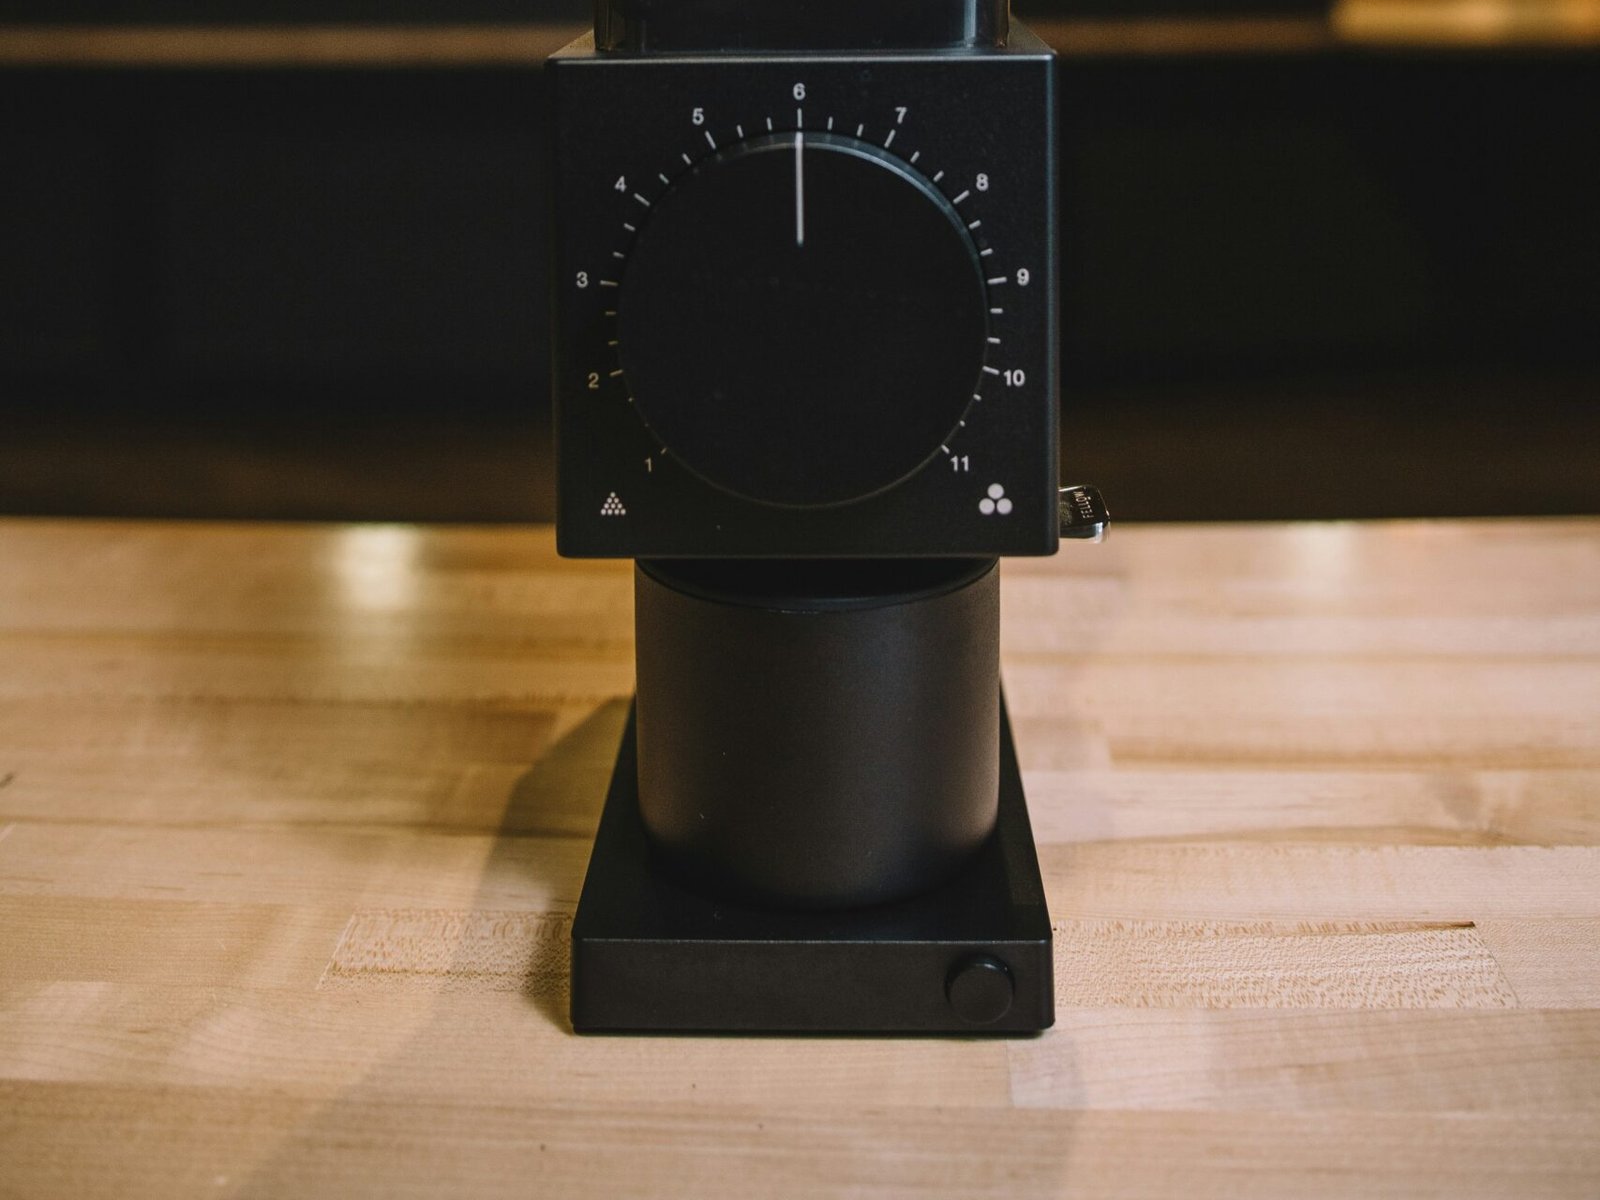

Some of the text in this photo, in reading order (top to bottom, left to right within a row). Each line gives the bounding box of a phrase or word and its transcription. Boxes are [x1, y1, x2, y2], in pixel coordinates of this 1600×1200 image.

[793, 82, 806, 100] 6
[692, 108, 705, 125] 5
[895, 107, 908, 124] 7
[614, 176, 627, 193] 4
[976, 174, 989, 191] 8
[576, 272, 589, 288] 3
[1016, 269, 1030, 286] 9
[588, 373, 599, 389] 2
[1003, 369, 1026, 387] 10
[645, 457, 653, 473] 1
[950, 456, 970, 473] 11
[1073, 491, 1094, 519] FELLOW
